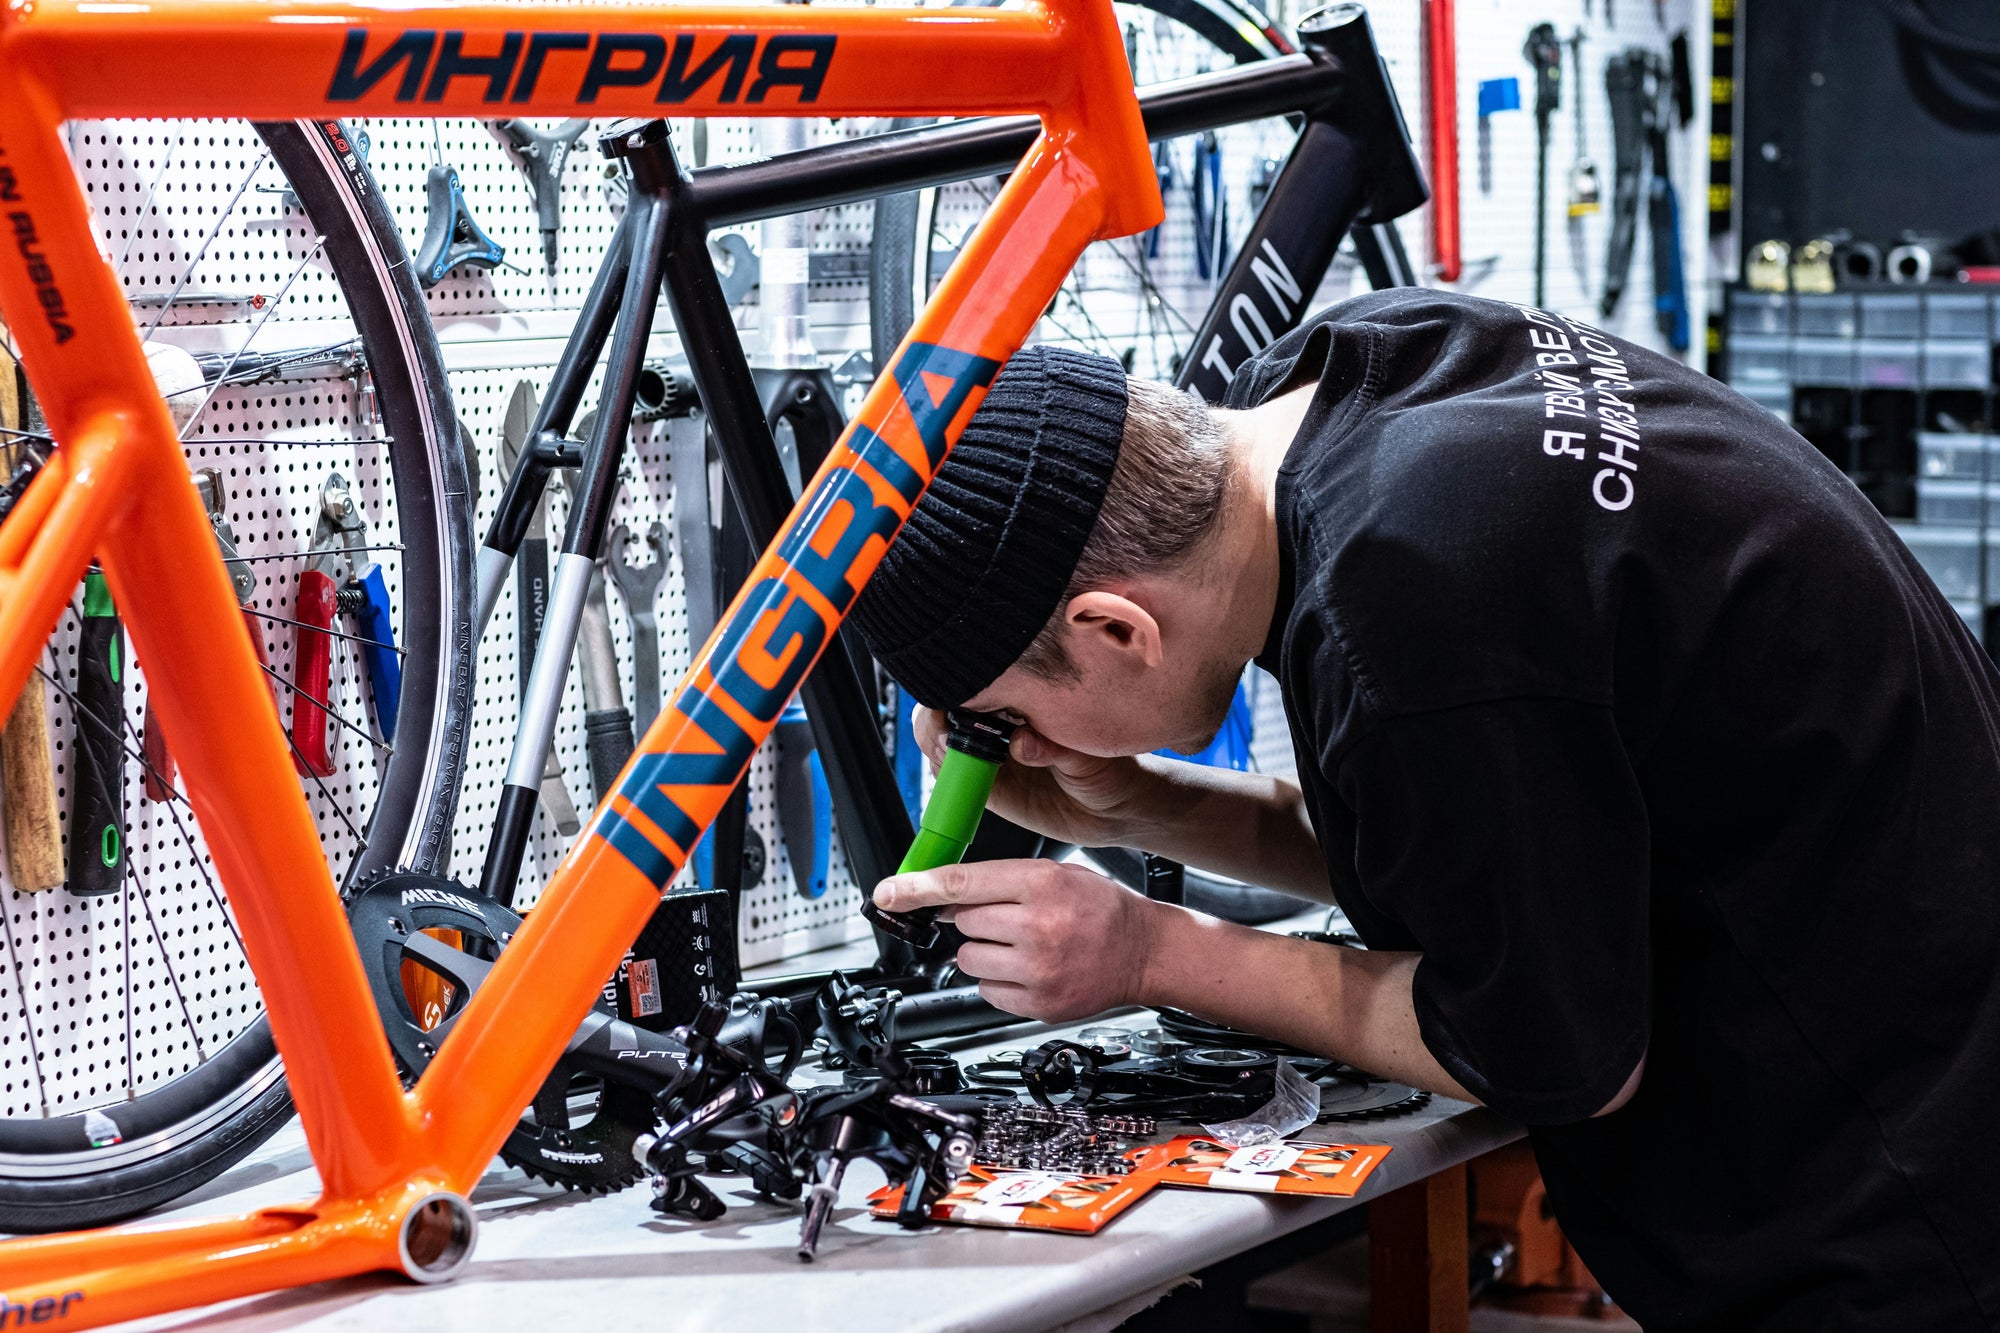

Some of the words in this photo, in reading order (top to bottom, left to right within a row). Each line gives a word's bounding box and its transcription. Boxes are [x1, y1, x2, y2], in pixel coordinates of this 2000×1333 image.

[326, 29, 837, 104] ИНГРИЯ
[8, 211, 75, 345] RUSSIA
[1188, 238, 1303, 402] TON
[1543, 429, 1586, 460] Я
[594, 342, 1003, 890] INGRIA
[401, 888, 487, 917] MICHE
